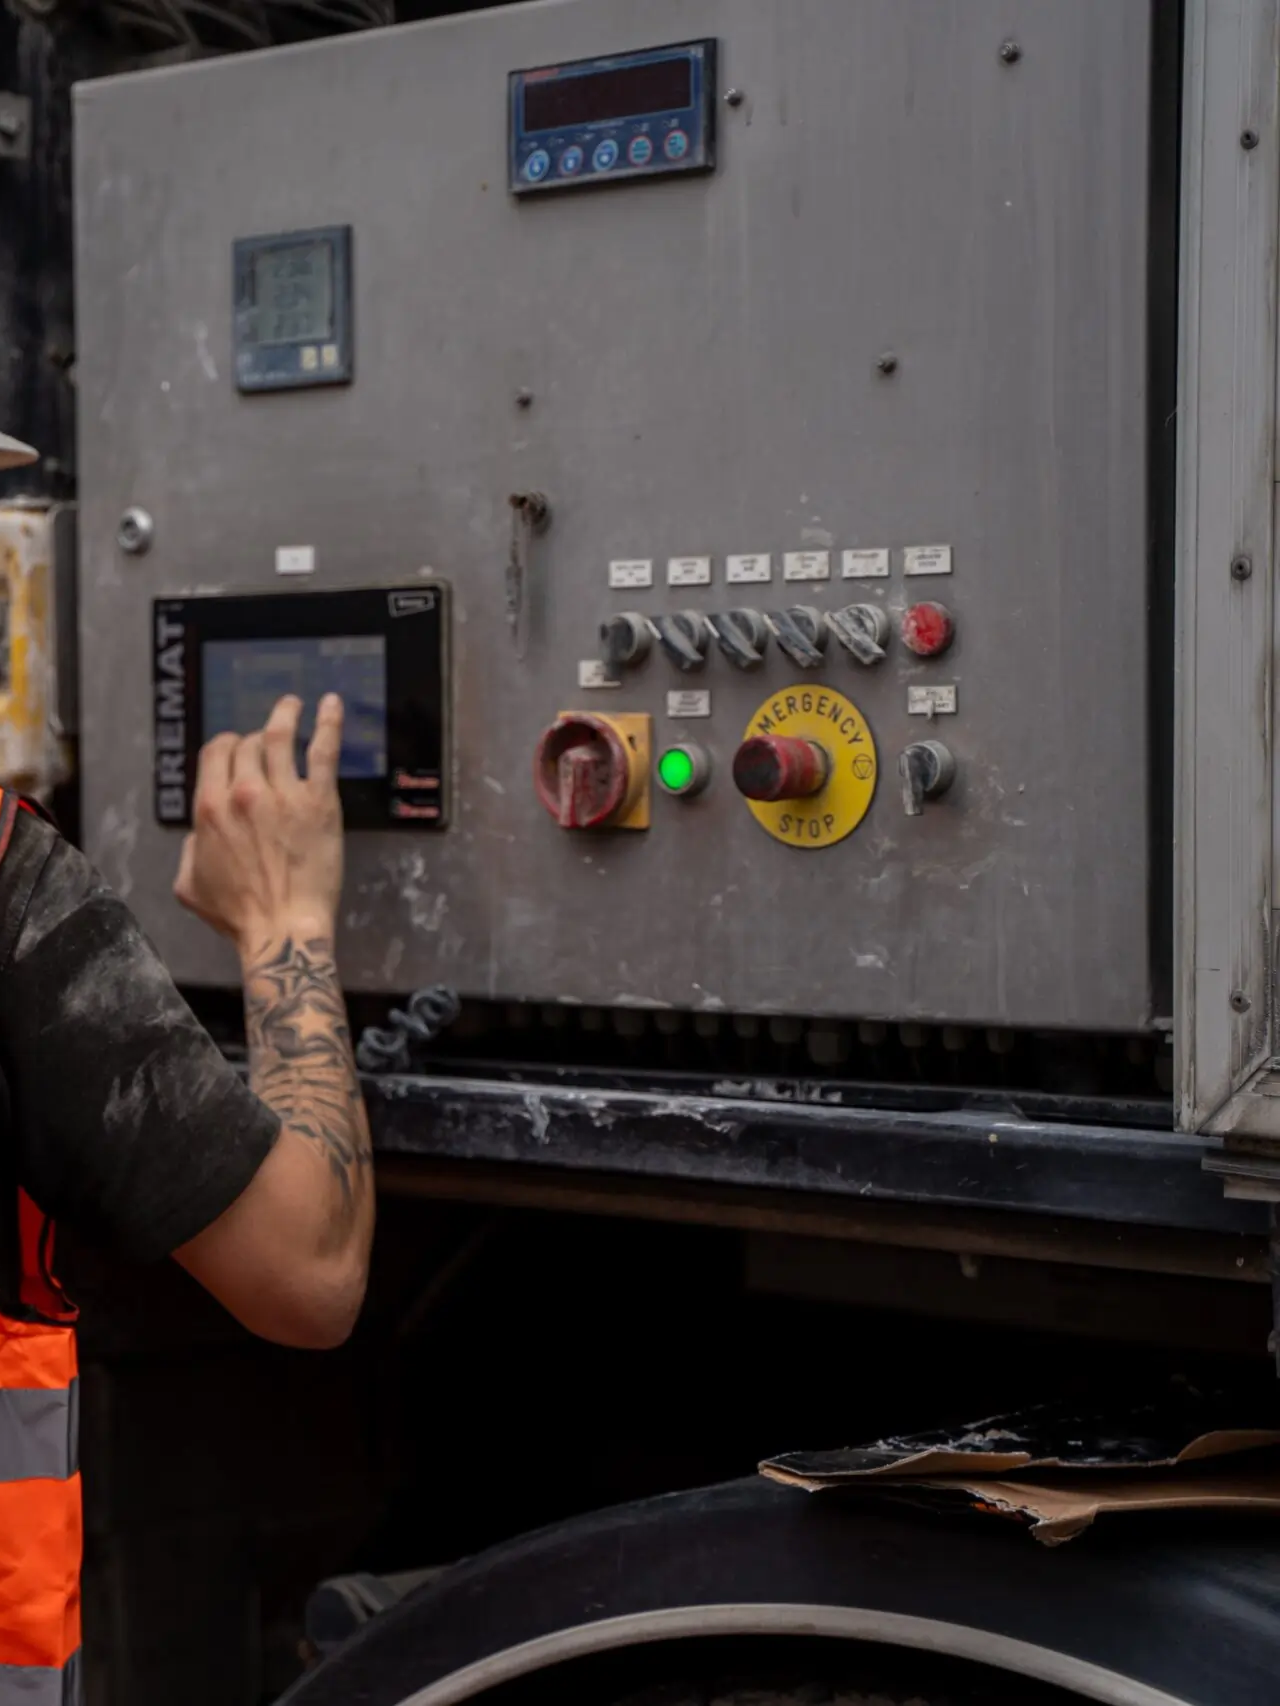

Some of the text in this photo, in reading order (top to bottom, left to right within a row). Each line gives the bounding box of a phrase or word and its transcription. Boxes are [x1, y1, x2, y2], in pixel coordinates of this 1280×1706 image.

[157, 613, 186, 819] BREMAT
[754, 692, 864, 745] MERGENCY
[779, 813, 834, 839] STOP
